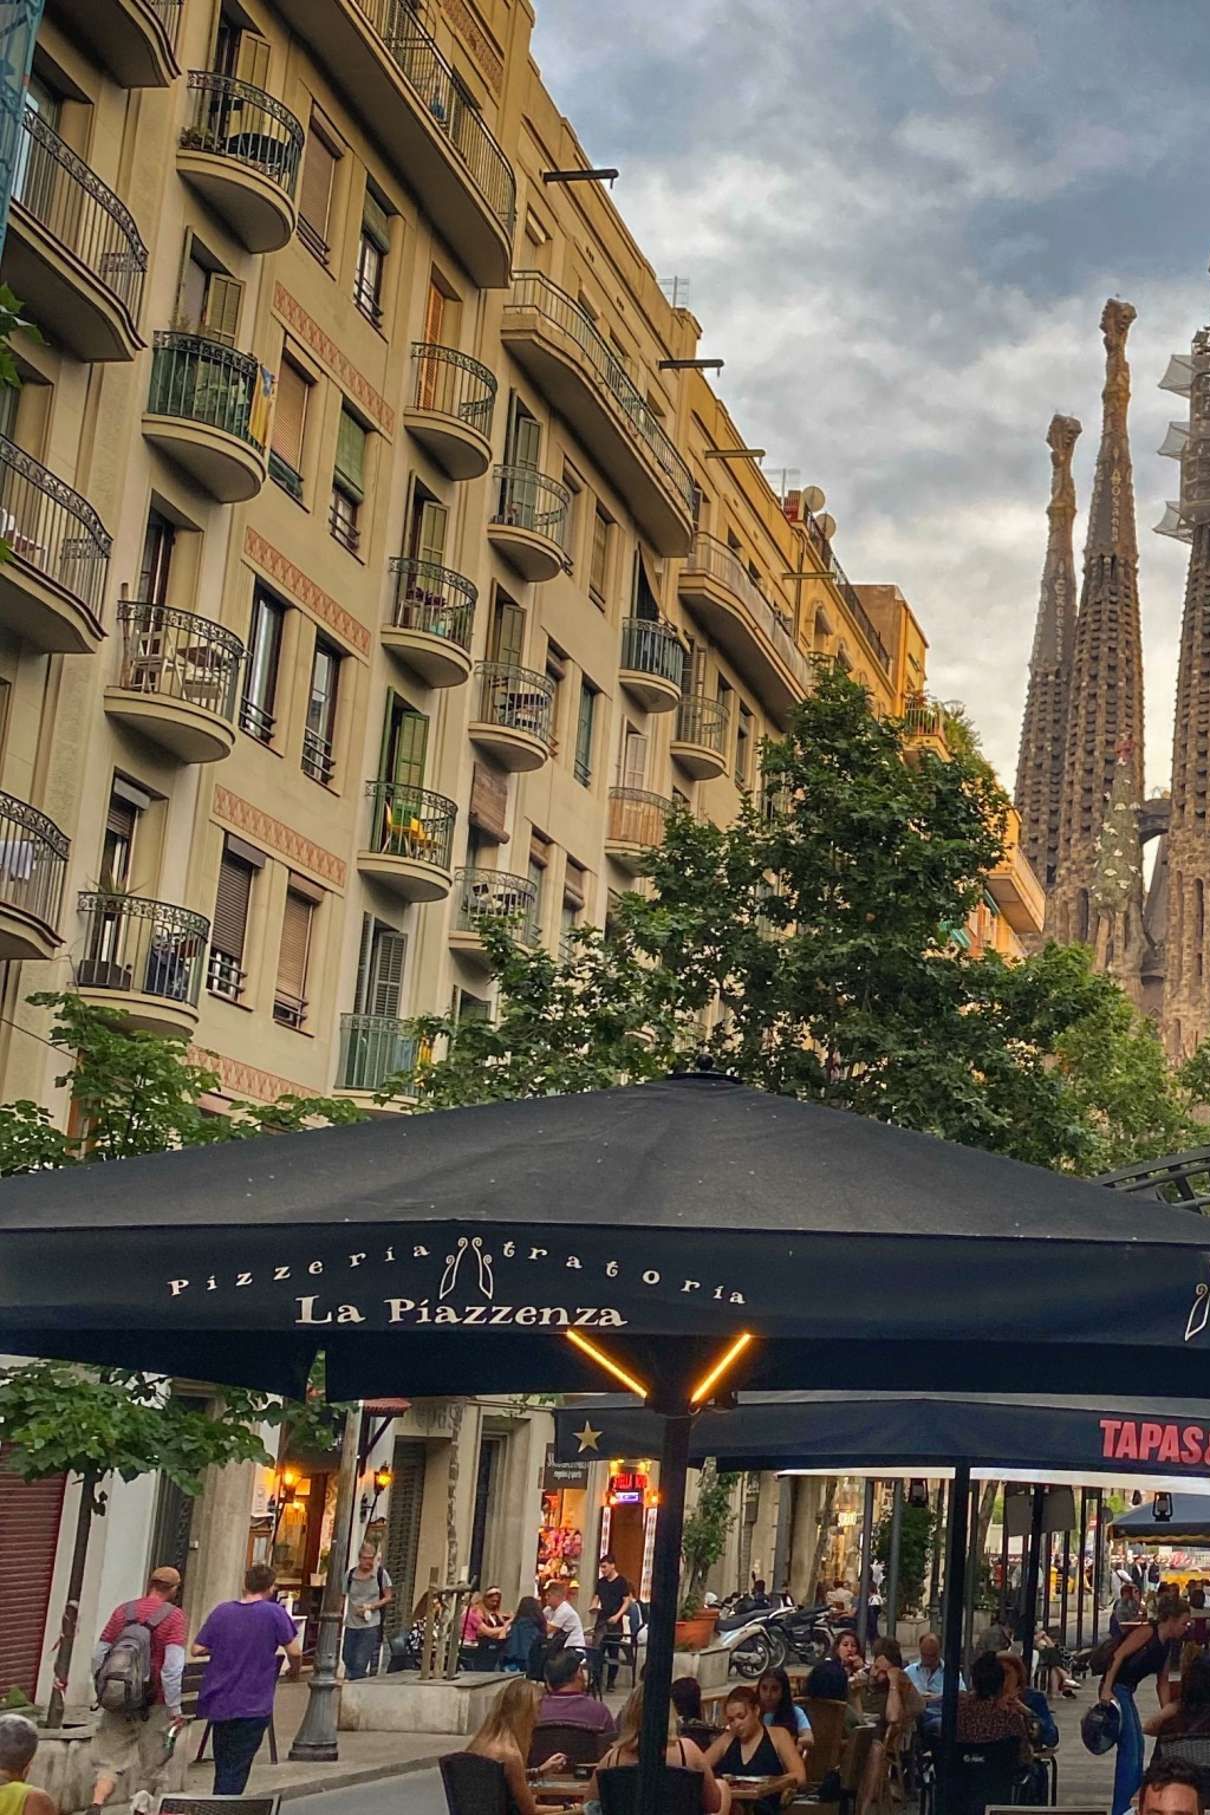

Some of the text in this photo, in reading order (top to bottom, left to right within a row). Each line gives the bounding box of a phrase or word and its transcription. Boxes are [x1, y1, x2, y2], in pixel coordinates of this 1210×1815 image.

[167, 1240, 746, 1304] Pizzeria tratoria
[295, 1295, 628, 1327] La Piazzenza
